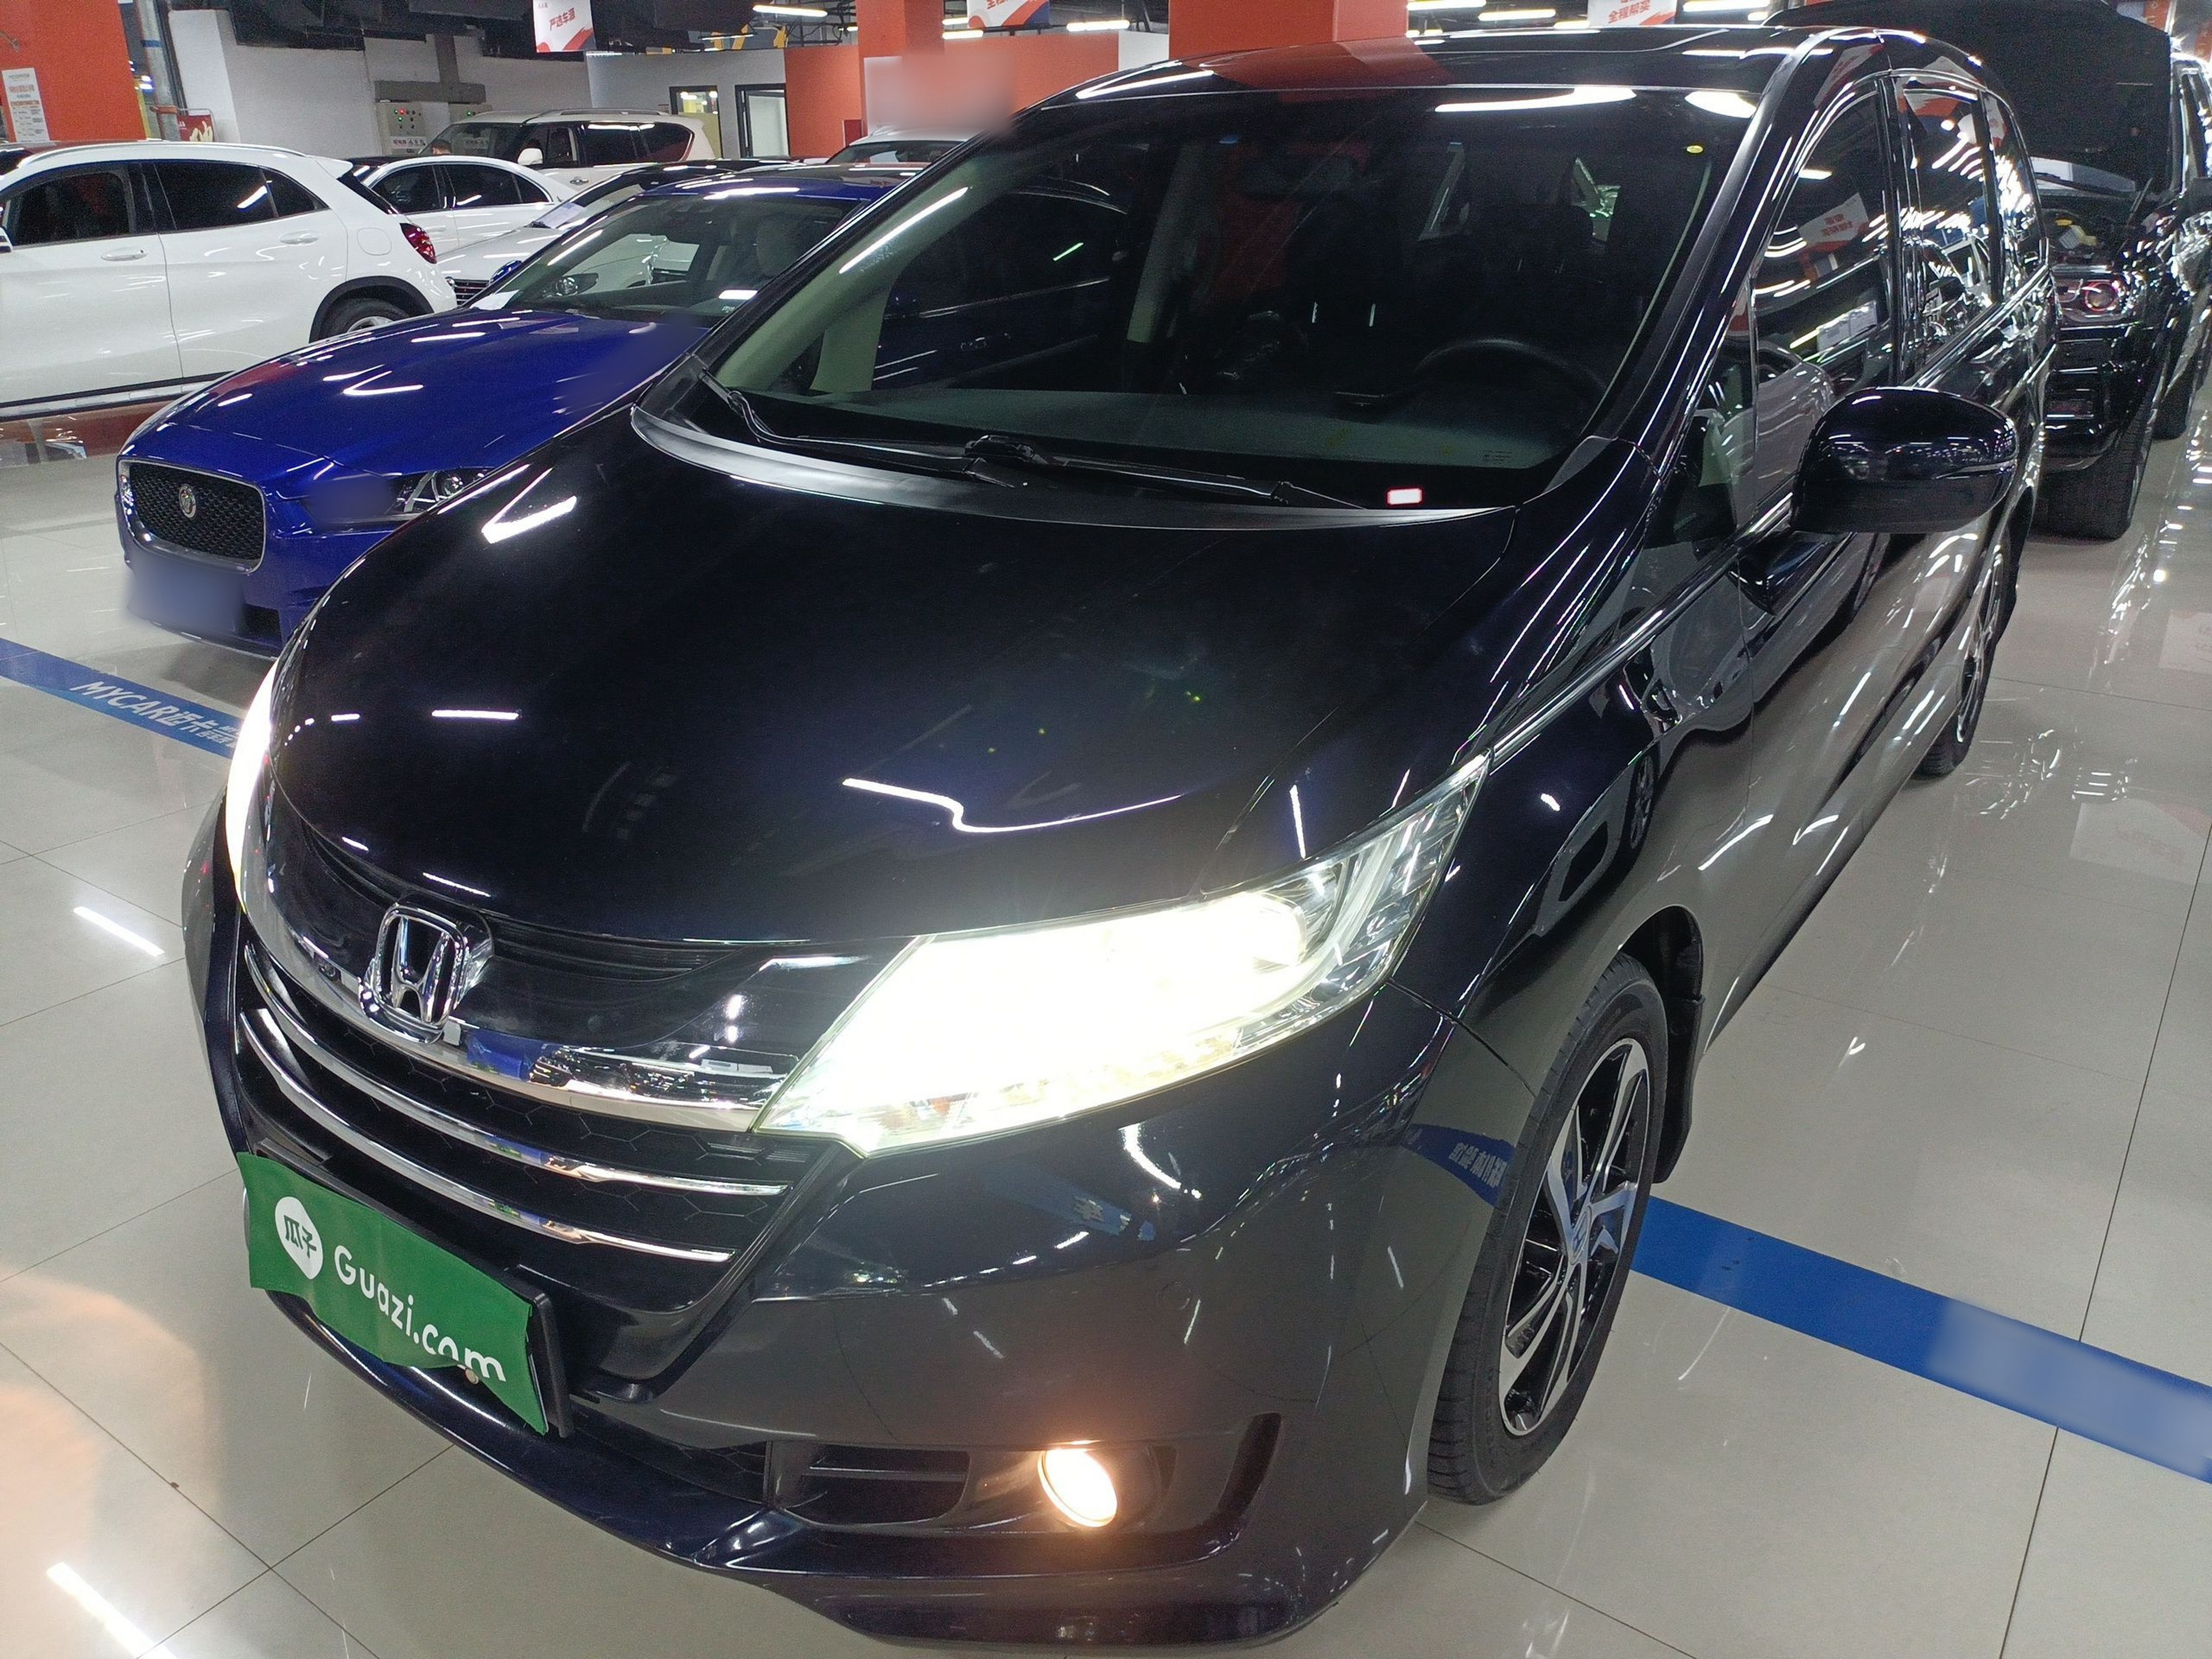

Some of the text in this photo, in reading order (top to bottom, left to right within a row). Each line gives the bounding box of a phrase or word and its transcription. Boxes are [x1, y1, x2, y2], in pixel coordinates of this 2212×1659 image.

[549, 7, 575, 31] 严选车源
[283, 1215, 316, 1259] 瓜子
[335, 1245, 506, 1382] Guazi.com
